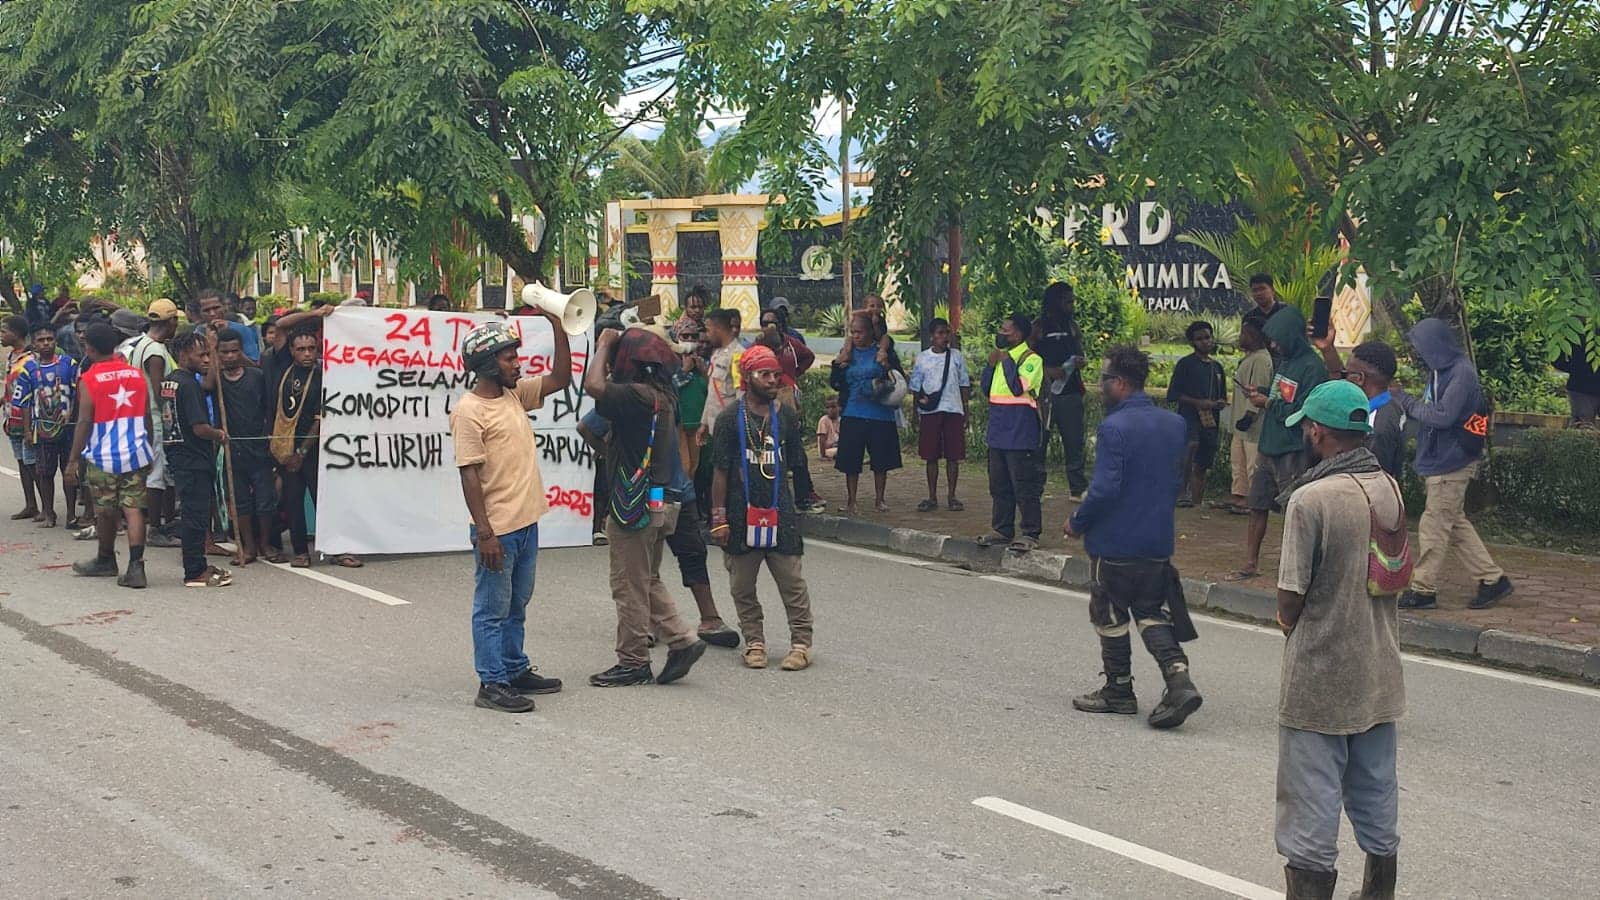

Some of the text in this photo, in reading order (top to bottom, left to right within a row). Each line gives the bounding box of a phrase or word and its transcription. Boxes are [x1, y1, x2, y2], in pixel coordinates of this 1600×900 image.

[1126, 263, 1233, 289] MIMIKA
[1148, 296, 1189, 311] PAPUA
[385, 313, 431, 346] 24
[321, 388, 429, 419] KOMODITI
[323, 432, 442, 469] SELURUH
